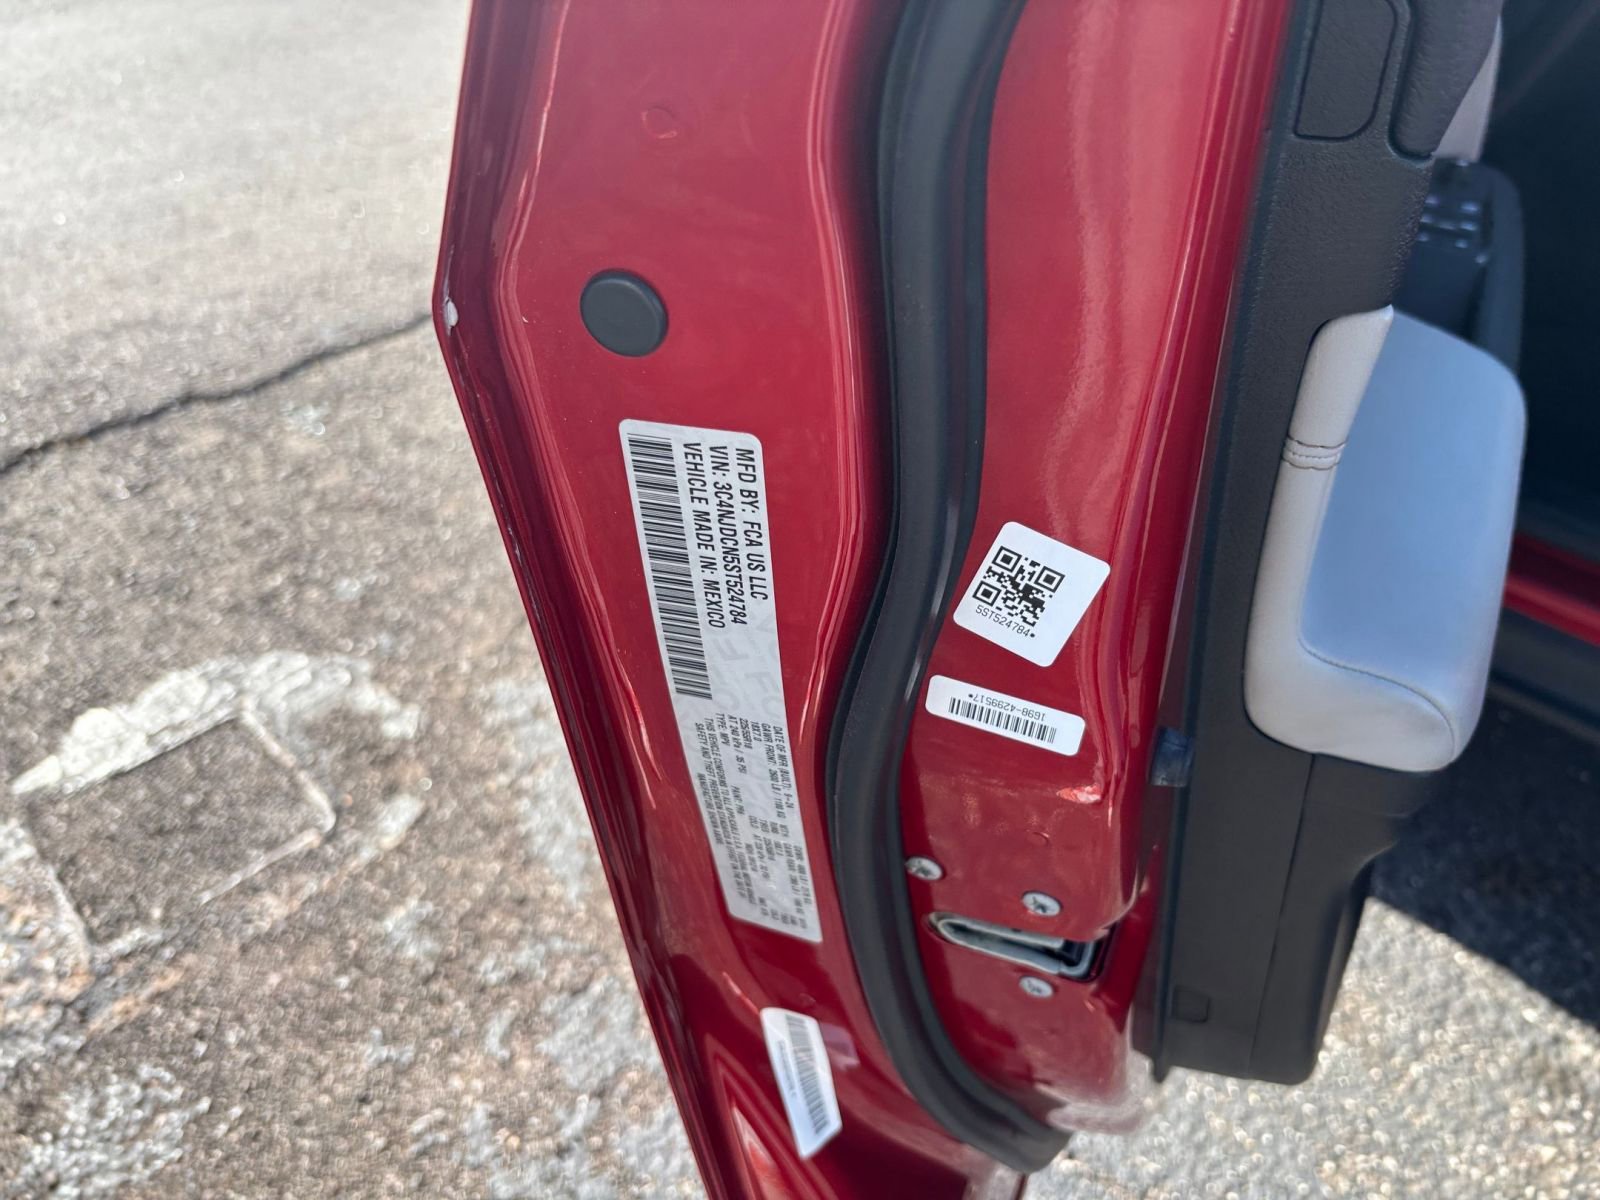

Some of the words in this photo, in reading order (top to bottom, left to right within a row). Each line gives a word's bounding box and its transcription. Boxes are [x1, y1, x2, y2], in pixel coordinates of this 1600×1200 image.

[682, 441, 709, 505] VEHICLE
[709, 444, 730, 477] VIN:
[735, 448, 756, 483] MFD
[740, 489, 759, 514] BY:
[692, 510, 715, 552] MADE
[743, 521, 763, 548] FCA
[699, 556, 718, 575] IN:
[714, 481, 748, 625] 3C4NJDCN5ST524784
[747, 553, 765, 572] US
[749, 576, 768, 601] LLC
[702, 579, 726, 629] MEXICO
[704, 717, 715, 732] THIS
[728, 714, 736, 724] AT
[773, 725, 783, 743] DATE
[776, 743, 784, 753] OF
